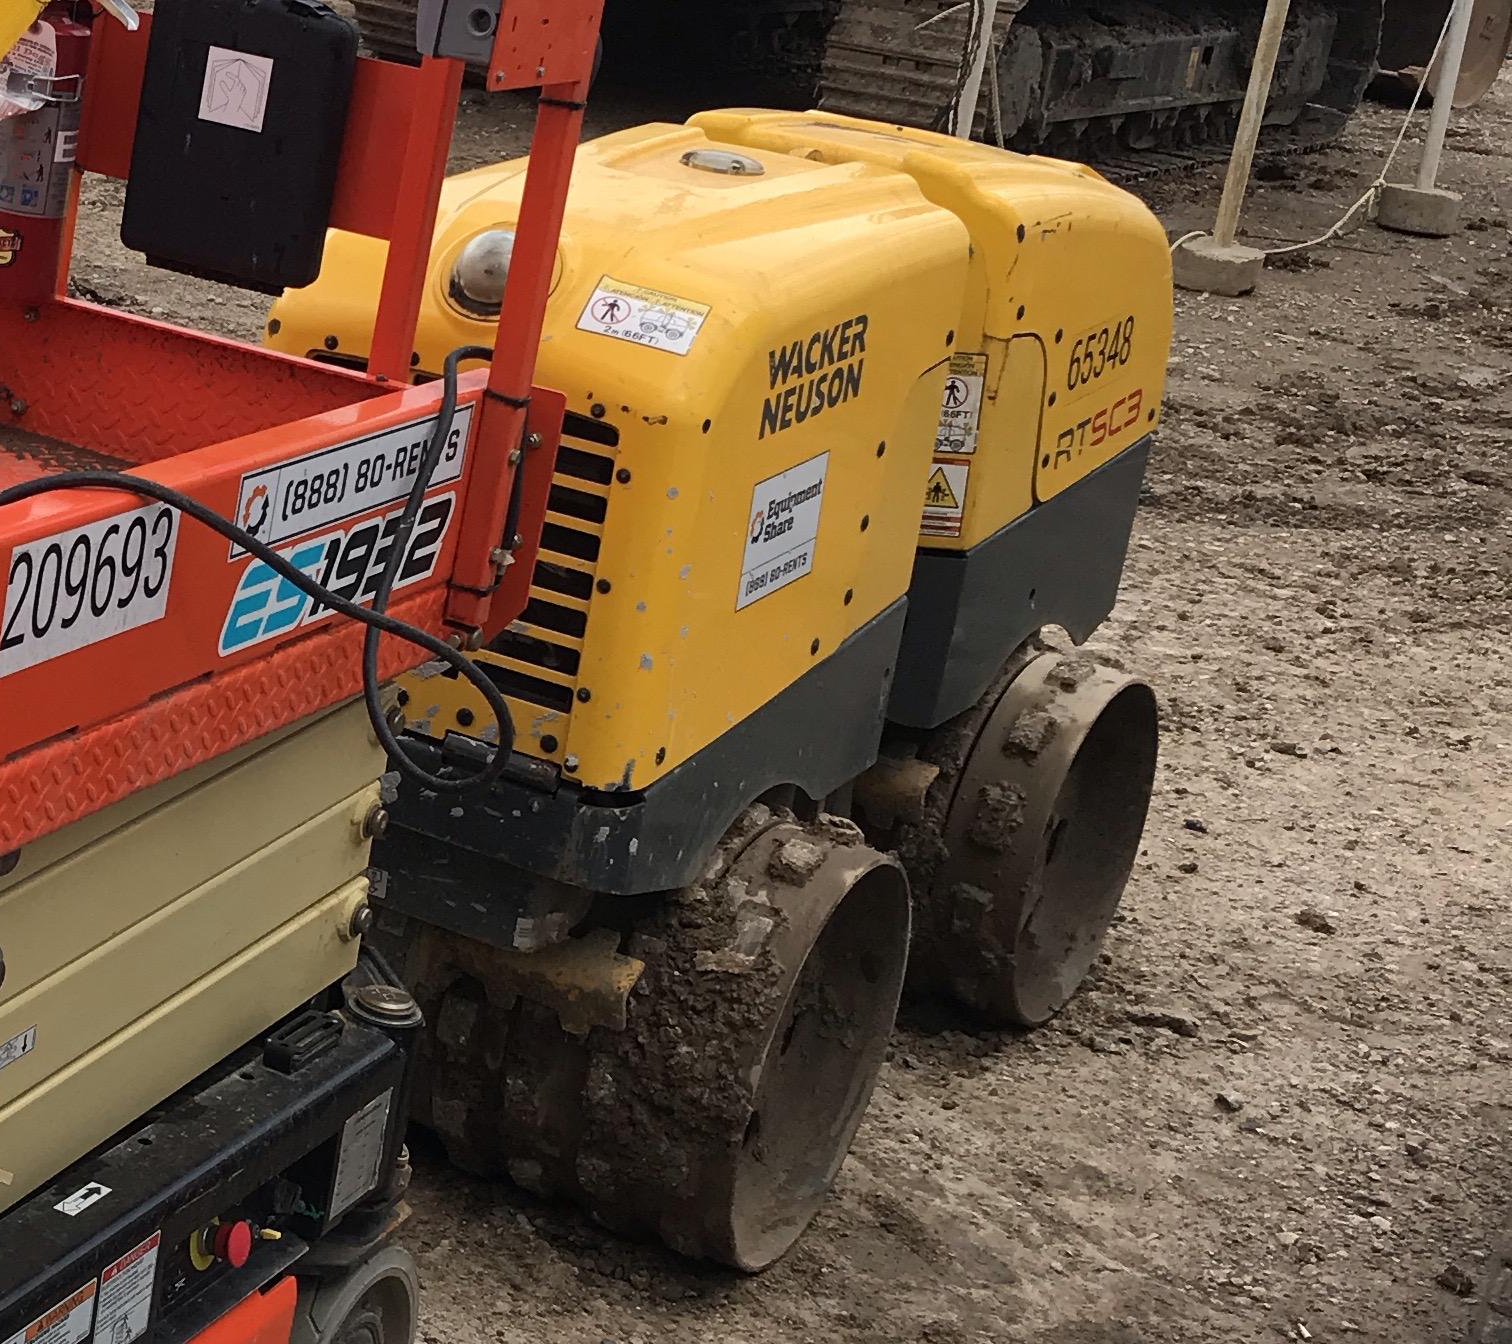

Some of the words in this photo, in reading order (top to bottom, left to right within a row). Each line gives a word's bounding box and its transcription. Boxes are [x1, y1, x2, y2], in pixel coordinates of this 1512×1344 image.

[768, 313, 869, 391] WACKER
[1067, 315, 1135, 391] 65348
[758, 358, 865, 441] NEUSON
[282, 462, 349, 522] (888)
[766, 478, 823, 521] Equipment
[763, 514, 795, 544] Share
[0, 505, 173, 652] 209693
[769, 552, 809, 585] 80-RENTS
